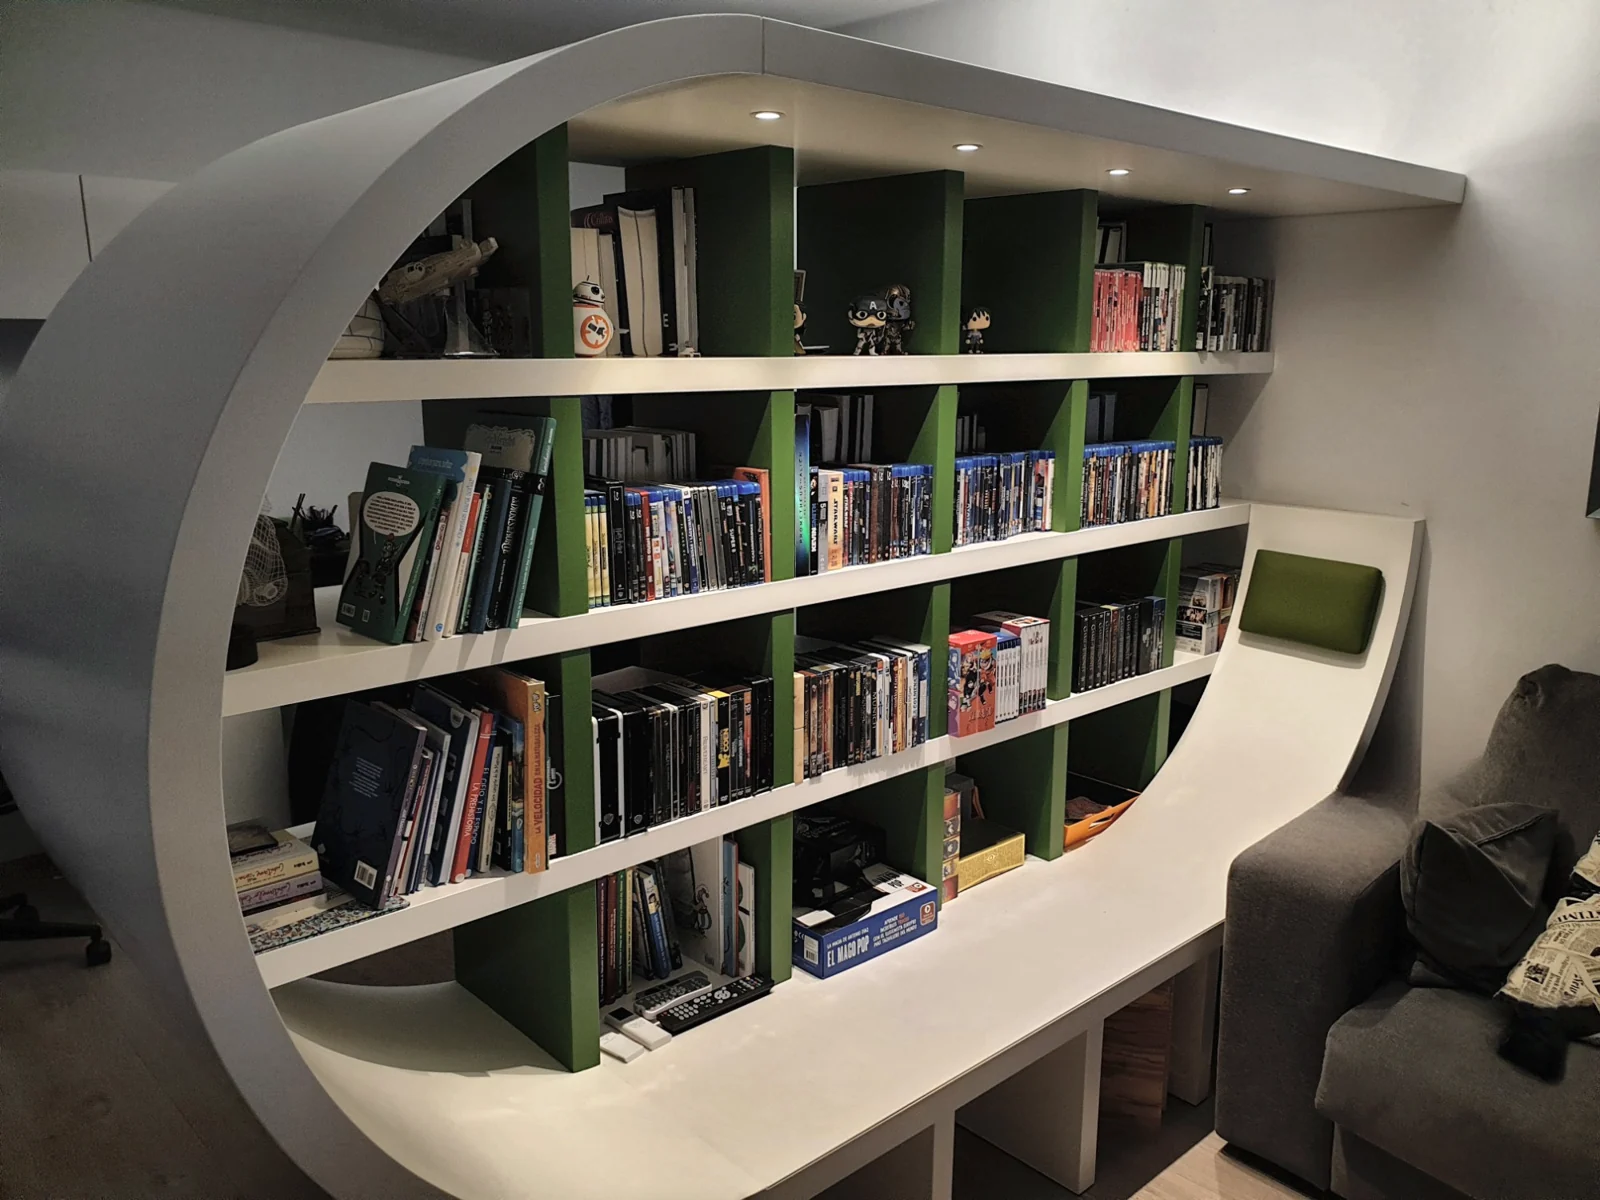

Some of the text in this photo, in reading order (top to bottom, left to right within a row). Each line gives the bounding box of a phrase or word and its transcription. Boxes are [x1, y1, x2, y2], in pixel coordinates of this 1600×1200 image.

[482, 767, 489, 775] EL
[478, 778, 488, 797] CIELO
[533, 777, 543, 826] VELOCIDAD
[464, 782, 480, 837] LA PREHISTORIA
[470, 817, 482, 845] ESPACIO
[534, 826, 542, 834] LA
[827, 935, 869, 968] EL MAGO POP
